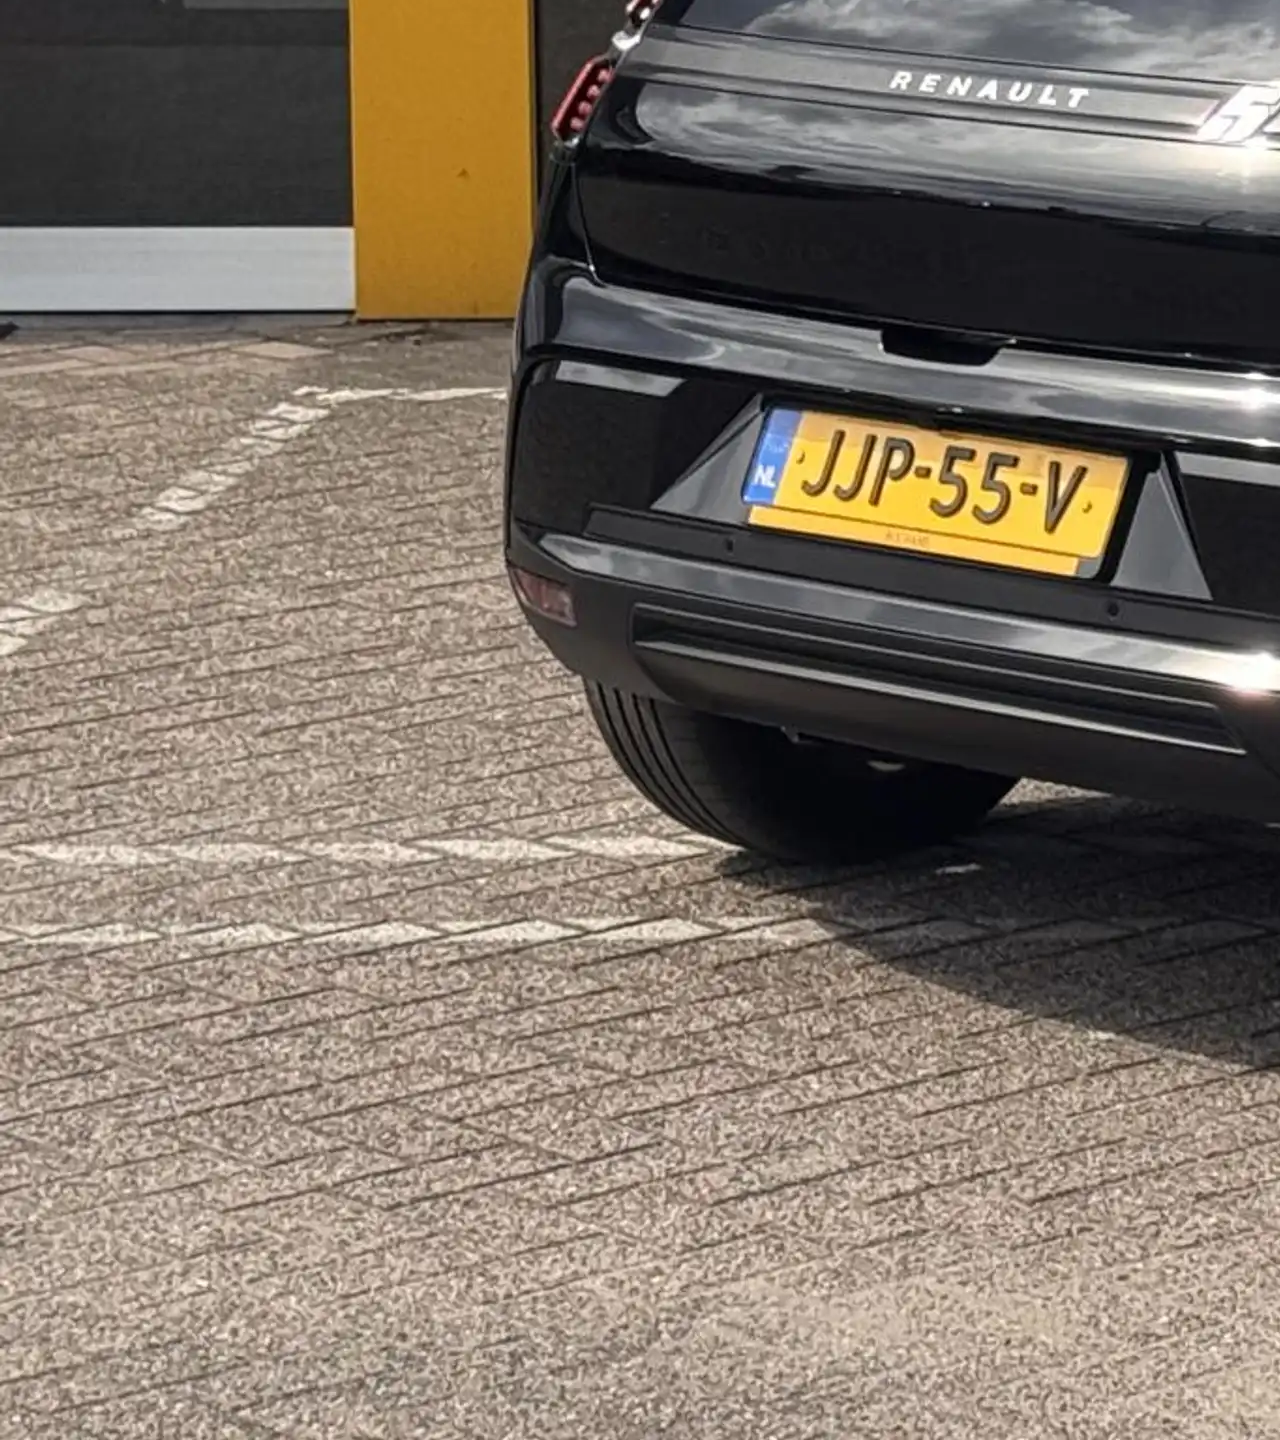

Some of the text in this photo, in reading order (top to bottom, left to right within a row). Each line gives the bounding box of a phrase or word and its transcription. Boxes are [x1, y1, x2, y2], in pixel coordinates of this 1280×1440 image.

[889, 70, 1092, 111] RENAULT
[754, 464, 777, 489] NL
[801, 428, 1088, 534] JJP-55-V
